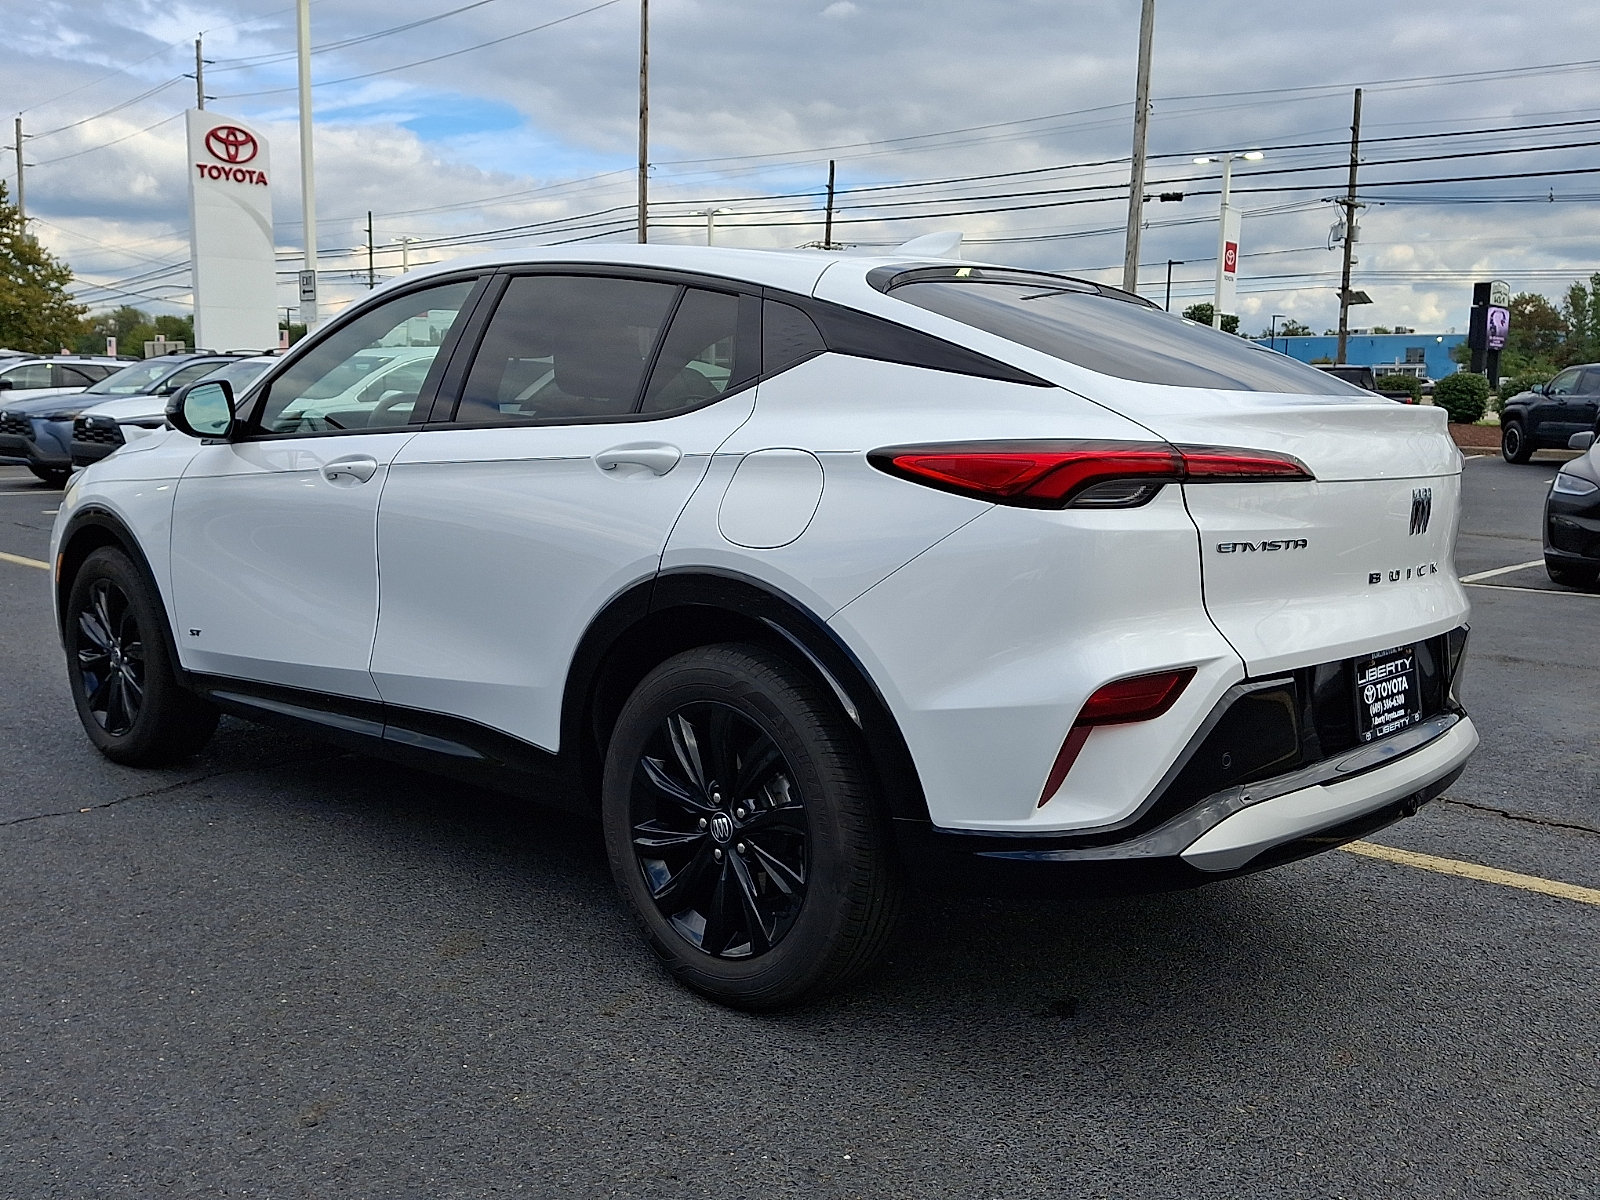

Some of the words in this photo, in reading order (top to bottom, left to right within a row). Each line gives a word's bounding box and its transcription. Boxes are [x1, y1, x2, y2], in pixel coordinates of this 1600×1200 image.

[196, 163, 268, 186] TOYOTA
[1216, 538, 1308, 554] ENVISTA
[1368, 562, 1439, 585] BUICK
[189, 628, 202, 637] ST
[1357, 656, 1413, 684] LIBERTY
[1376, 676, 1409, 698] TOYOTA
[1376, 716, 1410, 737] LIBERTY
